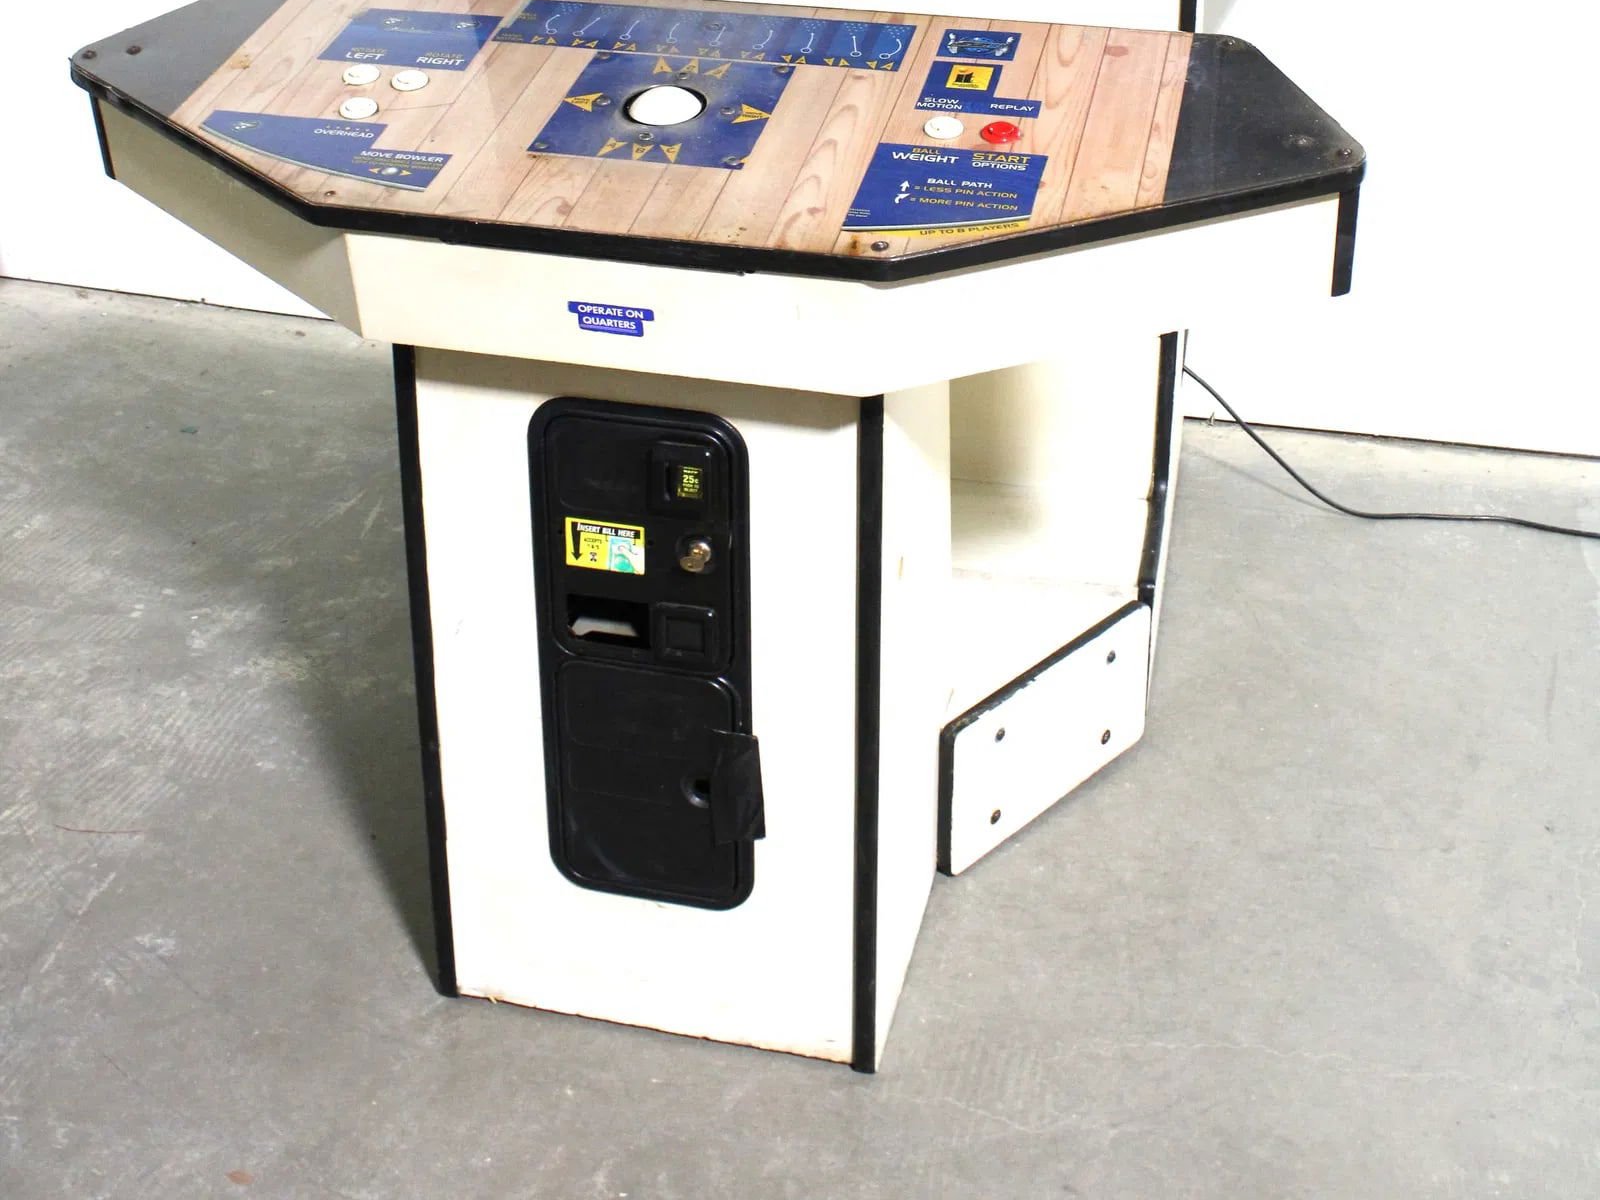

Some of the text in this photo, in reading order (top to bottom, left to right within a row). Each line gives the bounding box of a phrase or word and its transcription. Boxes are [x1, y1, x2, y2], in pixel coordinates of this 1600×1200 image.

[345, 51, 385, 61] LEFT
[416, 56, 465, 66] RIGHT
[916, 101, 963, 111] MOTION
[923, 97, 960, 105] SLOW
[989, 103, 1035, 112] REPLAY
[313, 128, 375, 139] OVERHEAD
[360, 150, 393, 159] MOVE
[395, 153, 444, 163] BOWLER
[911, 147, 940, 156] BALL
[892, 151, 960, 165] WEIGHT
[971, 152, 1031, 164] START
[971, 161, 1028, 171] OPTIONS
[926, 178, 993, 189] BALL PATH
[922, 185, 953, 194] LESS
[954, 187, 974, 196] PIN
[977, 189, 1018, 200] ACTION
[918, 197, 953, 206] MORE
[956, 199, 975, 208] PIN
[977, 202, 1018, 212] ACTION
[919, 229, 935, 237] UP
[937, 228, 954, 236] TO
[967, 222, 1020, 234] PLAYERS
[577, 304, 644, 319] OPERATE ON
[582, 316, 637, 330] QUARTERS
[576, 522, 636, 539] INSERT BILL HERE
